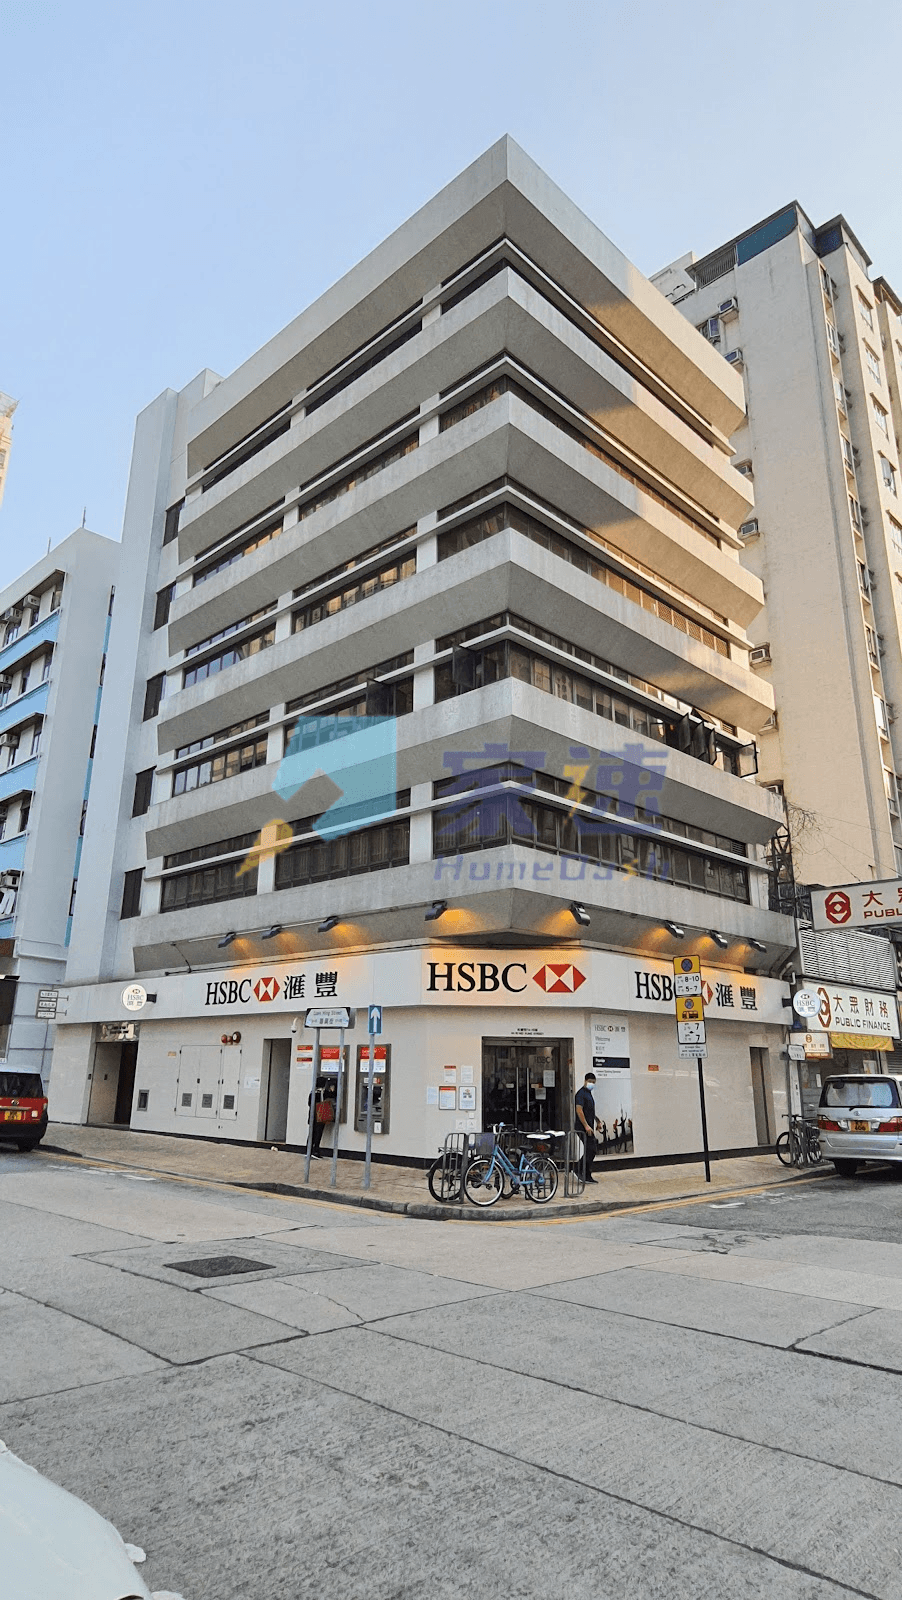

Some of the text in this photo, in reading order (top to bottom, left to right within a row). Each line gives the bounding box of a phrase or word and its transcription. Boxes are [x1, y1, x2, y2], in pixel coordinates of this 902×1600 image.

[283, 971, 338, 1000] 滙豐
[426, 962, 528, 993] HSBC
[684, 975, 700, 983] 8-10
[204, 978, 252, 1006] HSBC
[715, 982, 758, 1011] 滙豐
[694, 1022, 700, 1031] 7
[835, 1016, 891, 1031] PUBLIC FINANCE
[695, 1034, 701, 1042] 7
